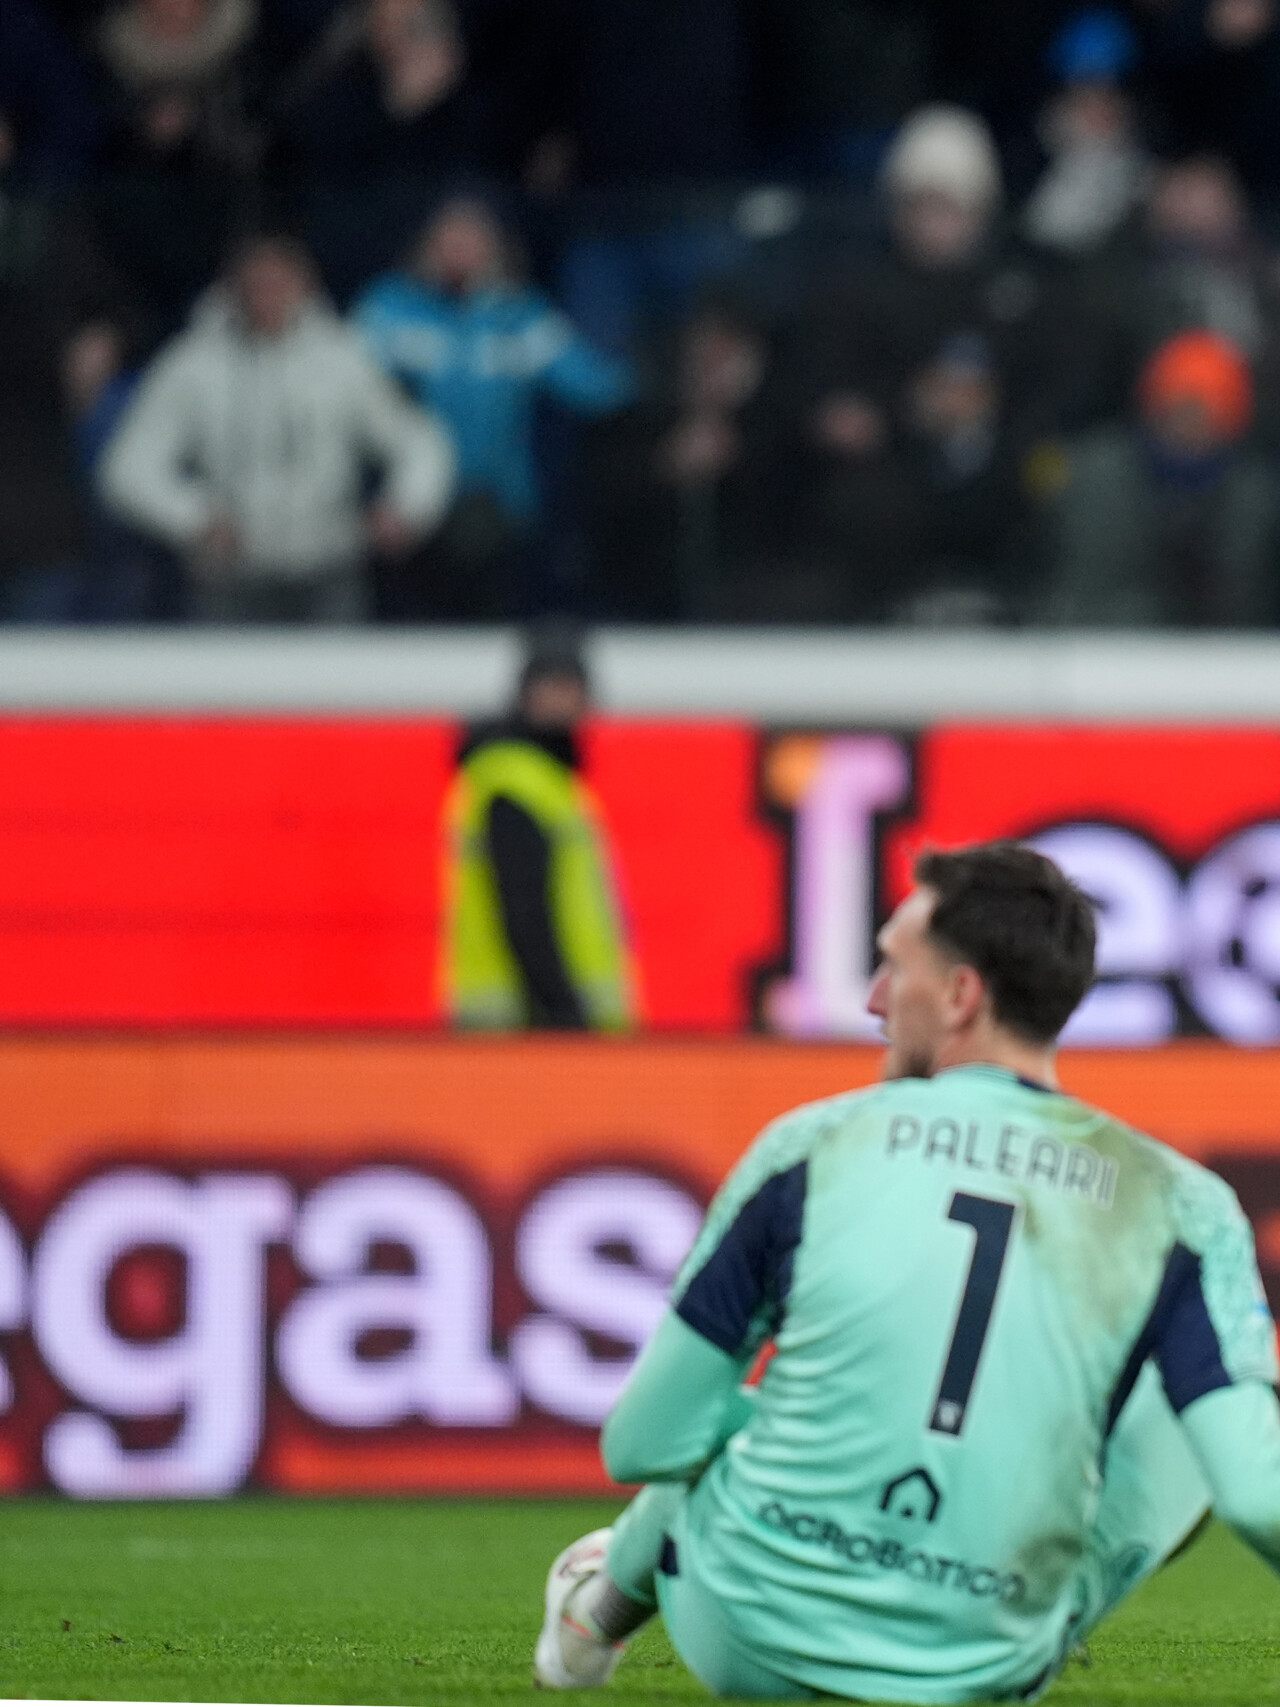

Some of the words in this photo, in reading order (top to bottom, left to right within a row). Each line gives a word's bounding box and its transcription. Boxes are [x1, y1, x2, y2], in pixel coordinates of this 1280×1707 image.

[885, 1114, 1119, 1210] PALEARI
[0, 1165, 702, 1498] gas
[929, 1191, 1016, 1437] 1
